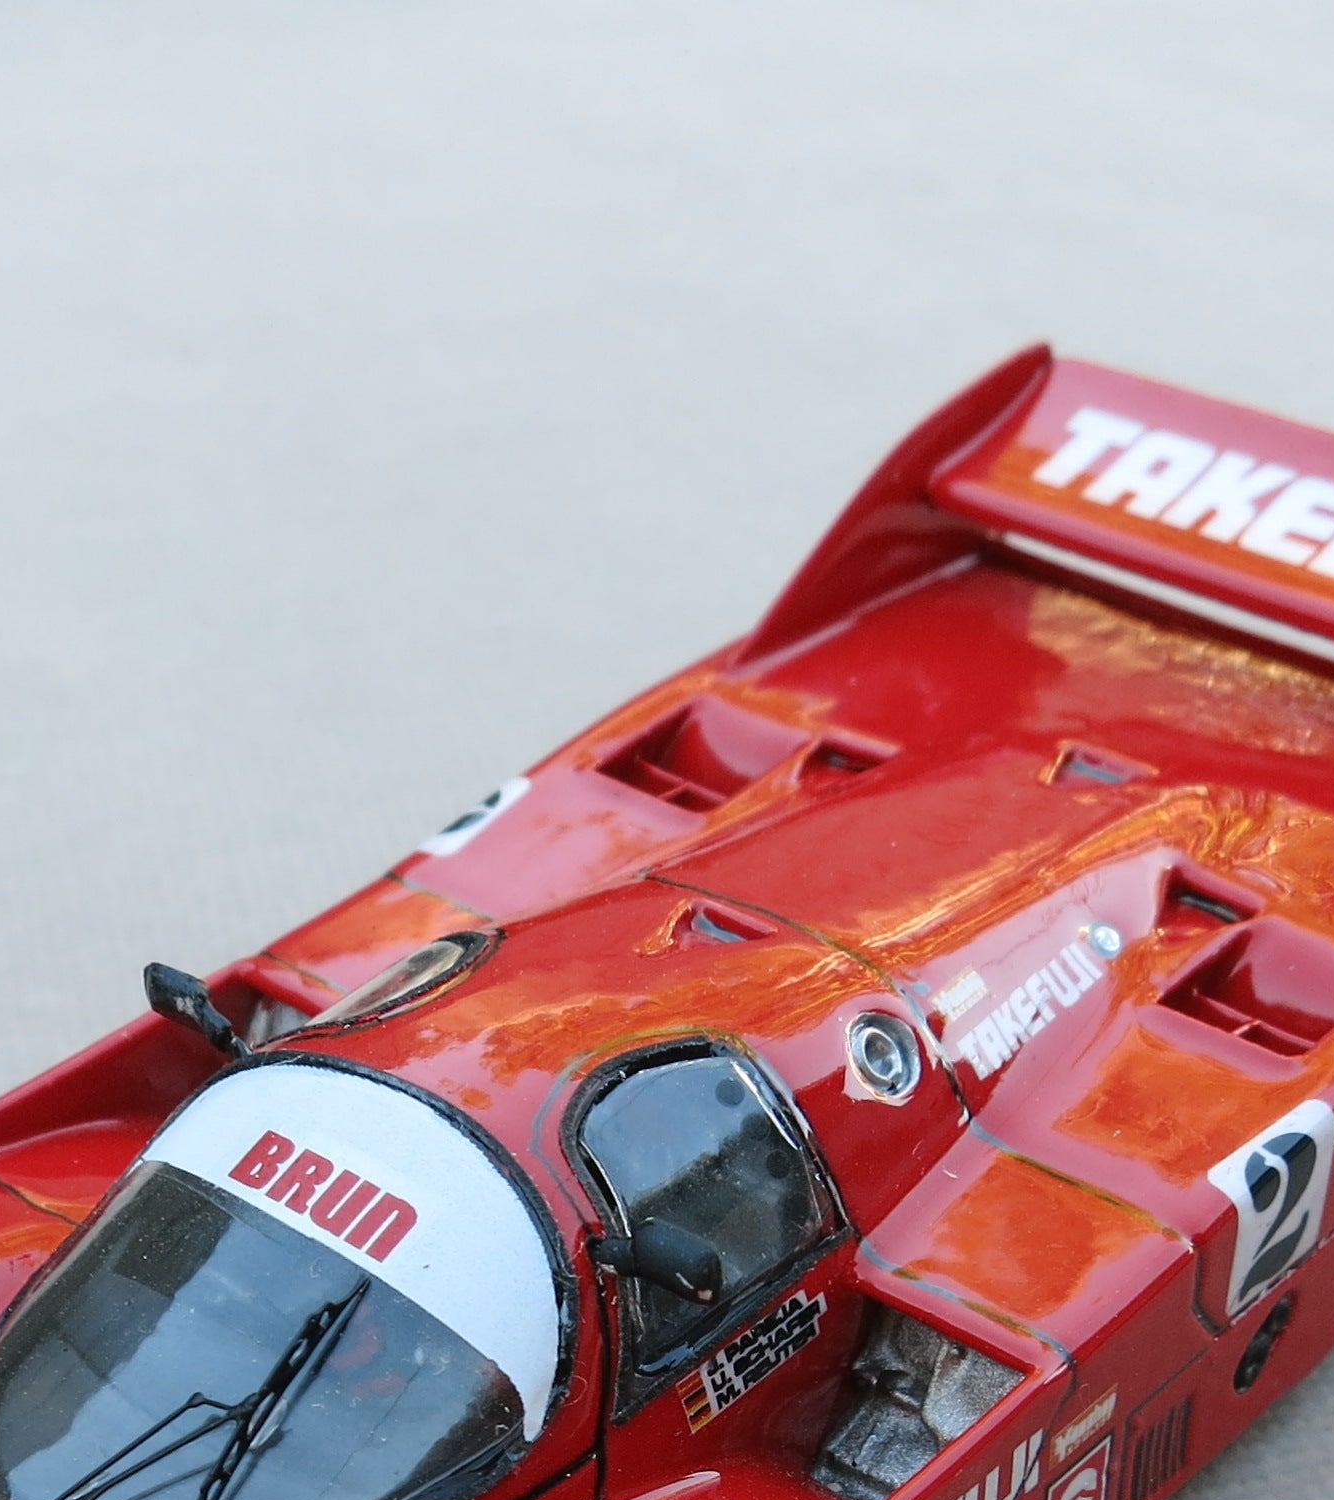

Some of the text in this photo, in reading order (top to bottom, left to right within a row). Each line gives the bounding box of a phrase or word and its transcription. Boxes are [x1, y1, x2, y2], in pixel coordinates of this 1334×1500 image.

[956, 942, 1103, 1081] TAKEFUJI
[227, 1129, 419, 1263] BRUN
[1239, 1130, 1318, 1300] 2
